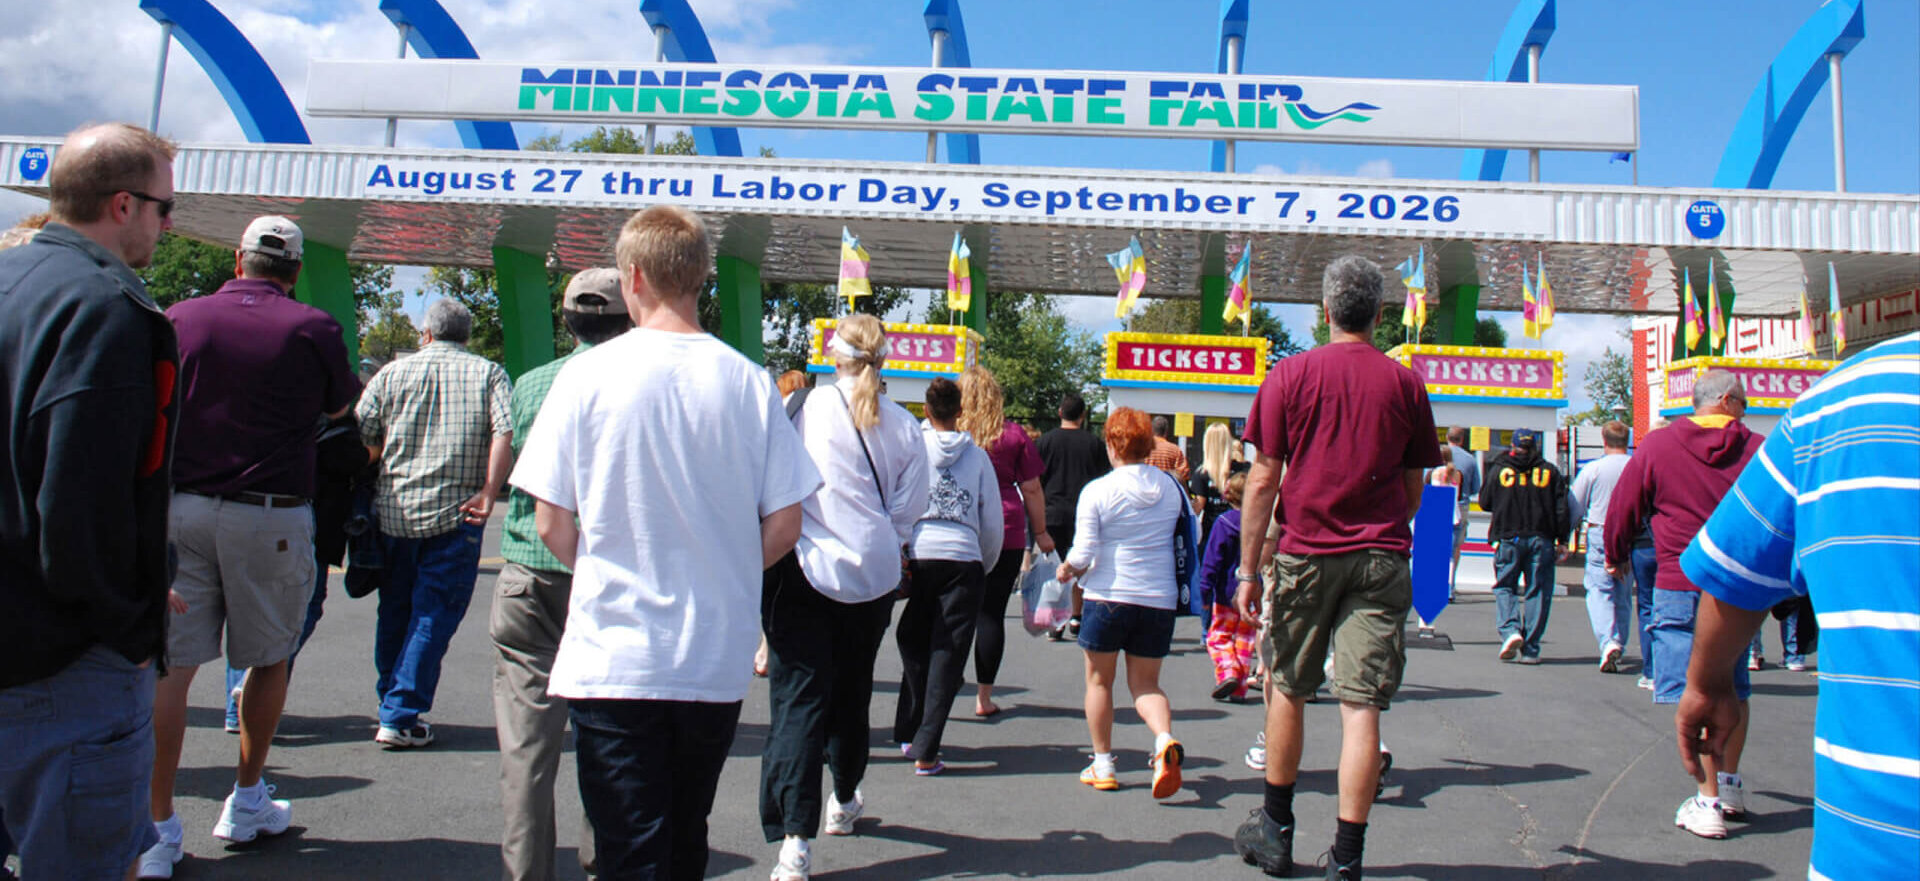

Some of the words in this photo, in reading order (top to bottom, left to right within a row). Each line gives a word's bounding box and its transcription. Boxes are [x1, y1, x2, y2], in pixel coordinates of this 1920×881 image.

[518, 68, 897, 118] MINNESOTA
[913, 73, 1127, 124] STATE
[1148, 79, 1312, 130] FAIR
[29, 159, 38, 170] 5
[367, 165, 516, 195] August
[532, 169, 583, 193] 27
[602, 171, 693, 196] thru
[712, 174, 847, 201] Labor
[858, 179, 960, 212] Day,
[982, 182, 1256, 215] September
[1274, 191, 1317, 223] 7,
[1337, 193, 1460, 223] 2026
[1691, 205, 1719, 214] GATE
[1699, 214, 1711, 227] 5
[887, 336, 943, 358] KETS
[1131, 347, 1243, 371] TICKETS
[1425, 359, 1539, 383] TICKETS
[1733, 372, 1821, 393] ICKE
